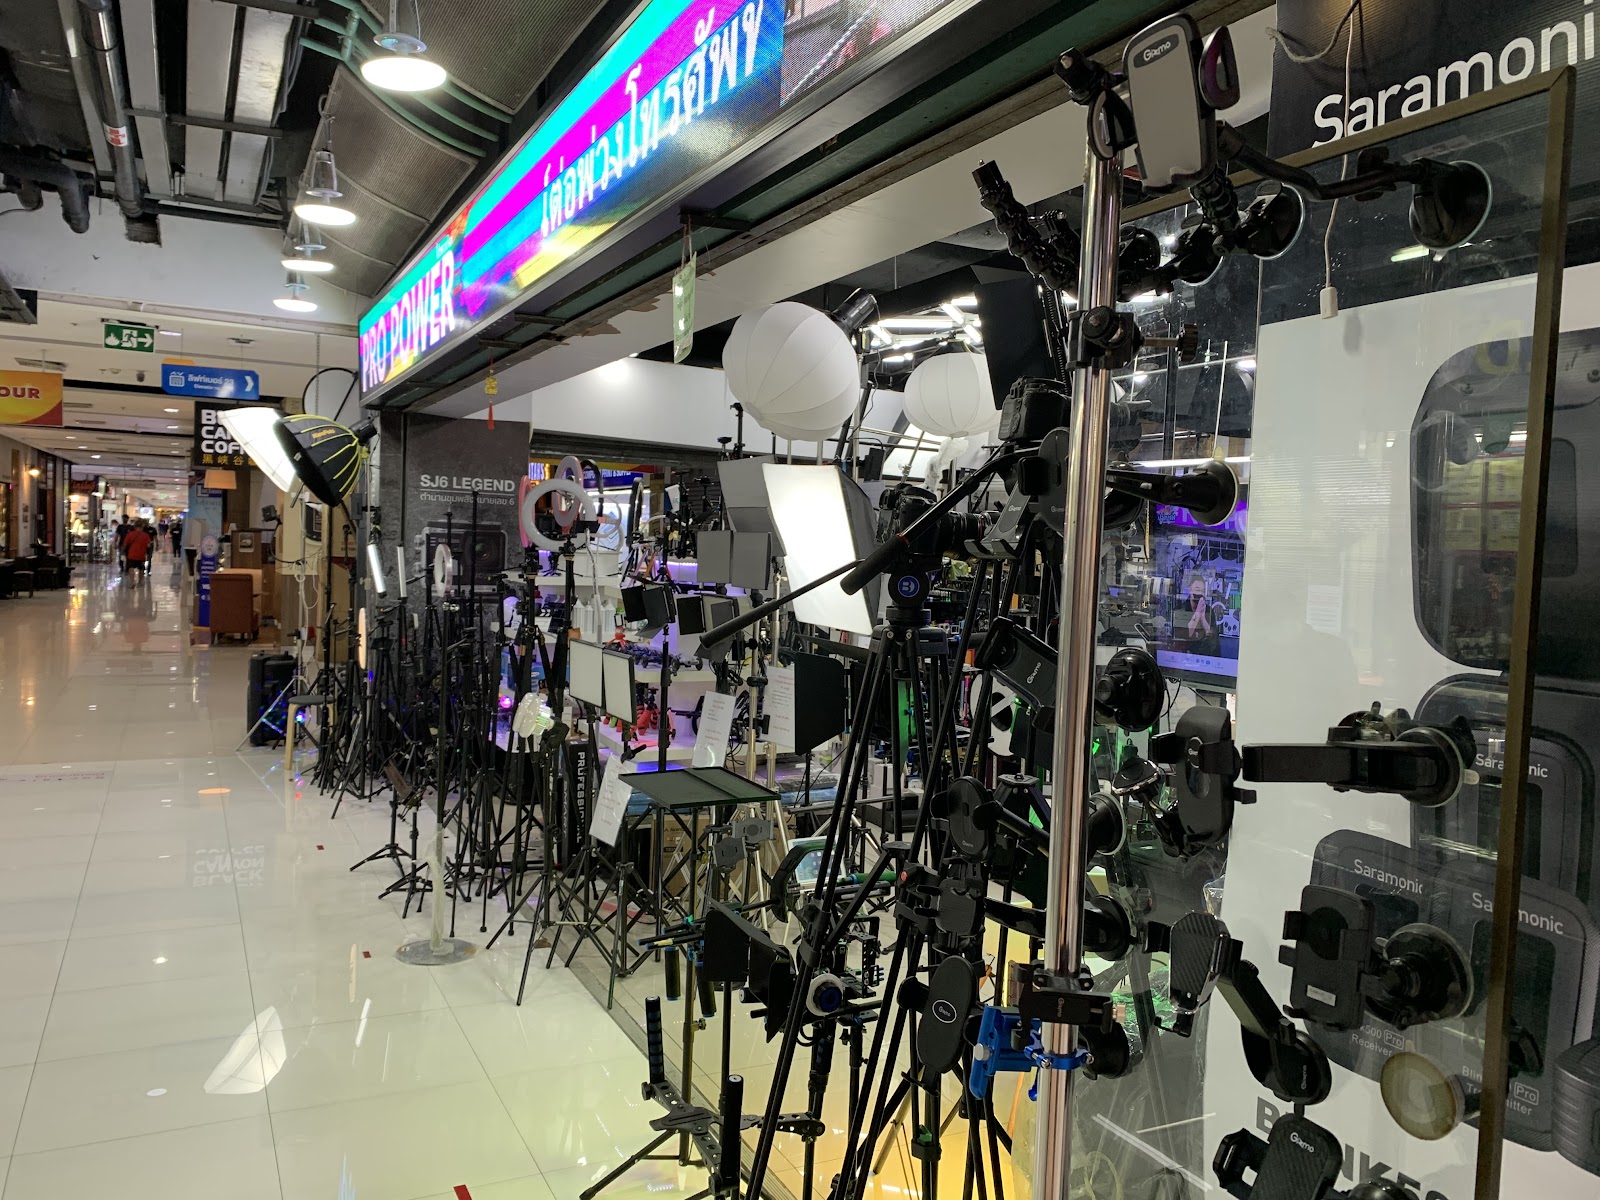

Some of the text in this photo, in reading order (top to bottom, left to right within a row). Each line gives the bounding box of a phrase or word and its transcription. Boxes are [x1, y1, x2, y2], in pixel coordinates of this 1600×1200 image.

[361, 250, 455, 392] PRO POWER
[420, 474, 515, 492] SJ6 LEGEND
[1351, 1033, 1393, 1058] Receiver
[1385, 1032, 1402, 1047] Pro
[1516, 1085, 1537, 1102] Pro
[1290, 1131, 1315, 1153] Gizmo
